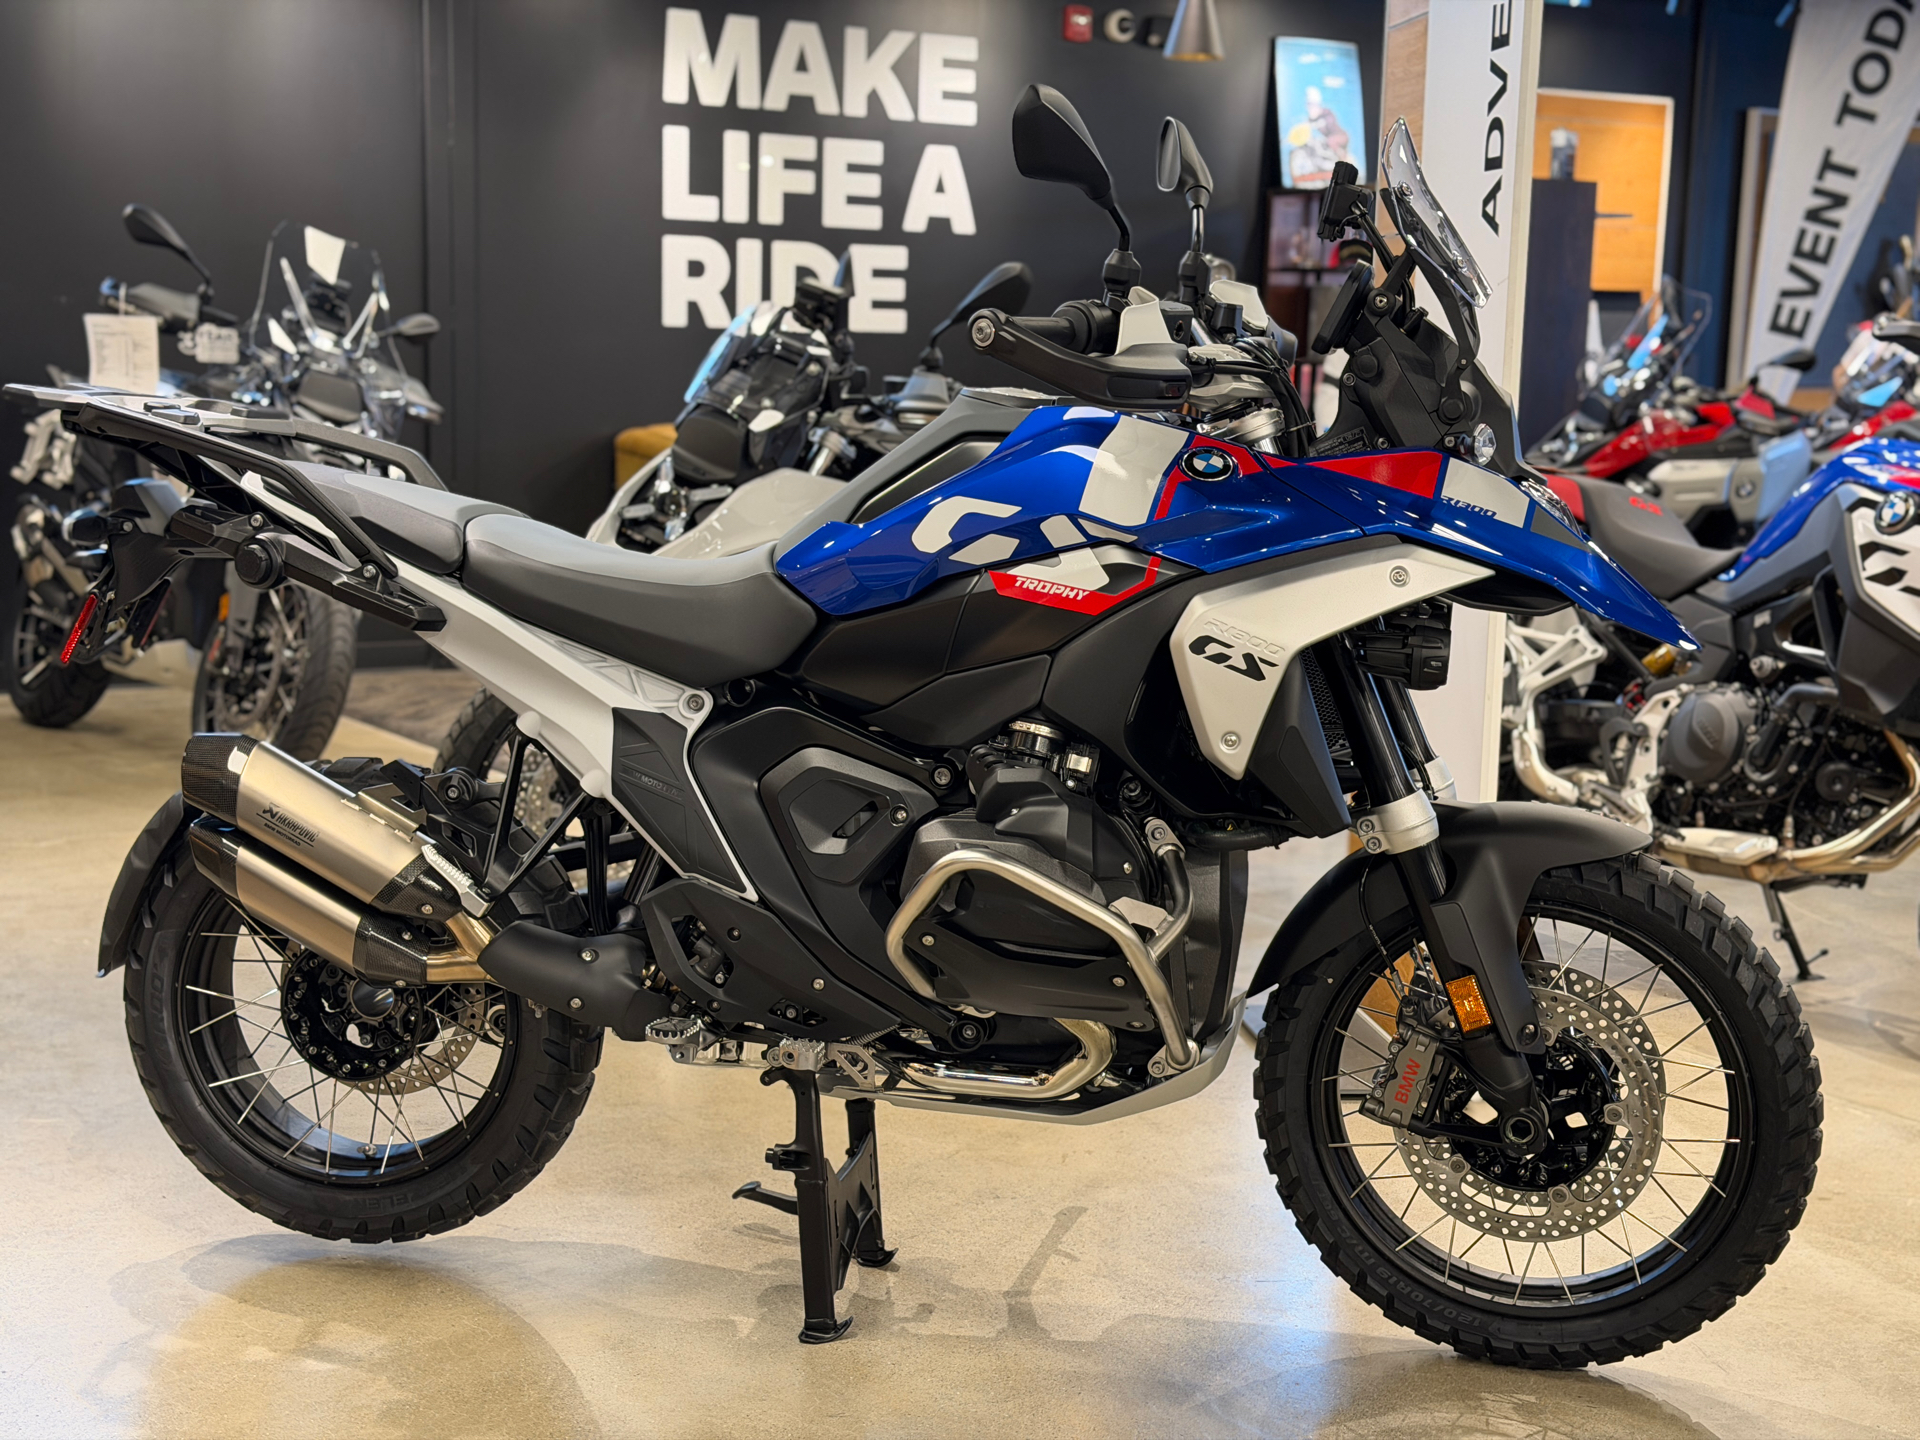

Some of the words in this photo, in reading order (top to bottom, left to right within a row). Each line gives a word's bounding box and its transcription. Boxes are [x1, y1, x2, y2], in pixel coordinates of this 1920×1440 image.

[662, 7, 978, 126] MAKE
[661, 124, 884, 231] LIFE
[902, 143, 977, 235] A
[1769, 146, 1859, 339] EVENT
[1835, 0, 1914, 127] TOD
[661, 233, 909, 338] RIDE
[1014, 576, 1090, 600] TROPHY
[1188, 634, 1279, 682] GS
[1394, 1057, 1421, 1105] BMW
